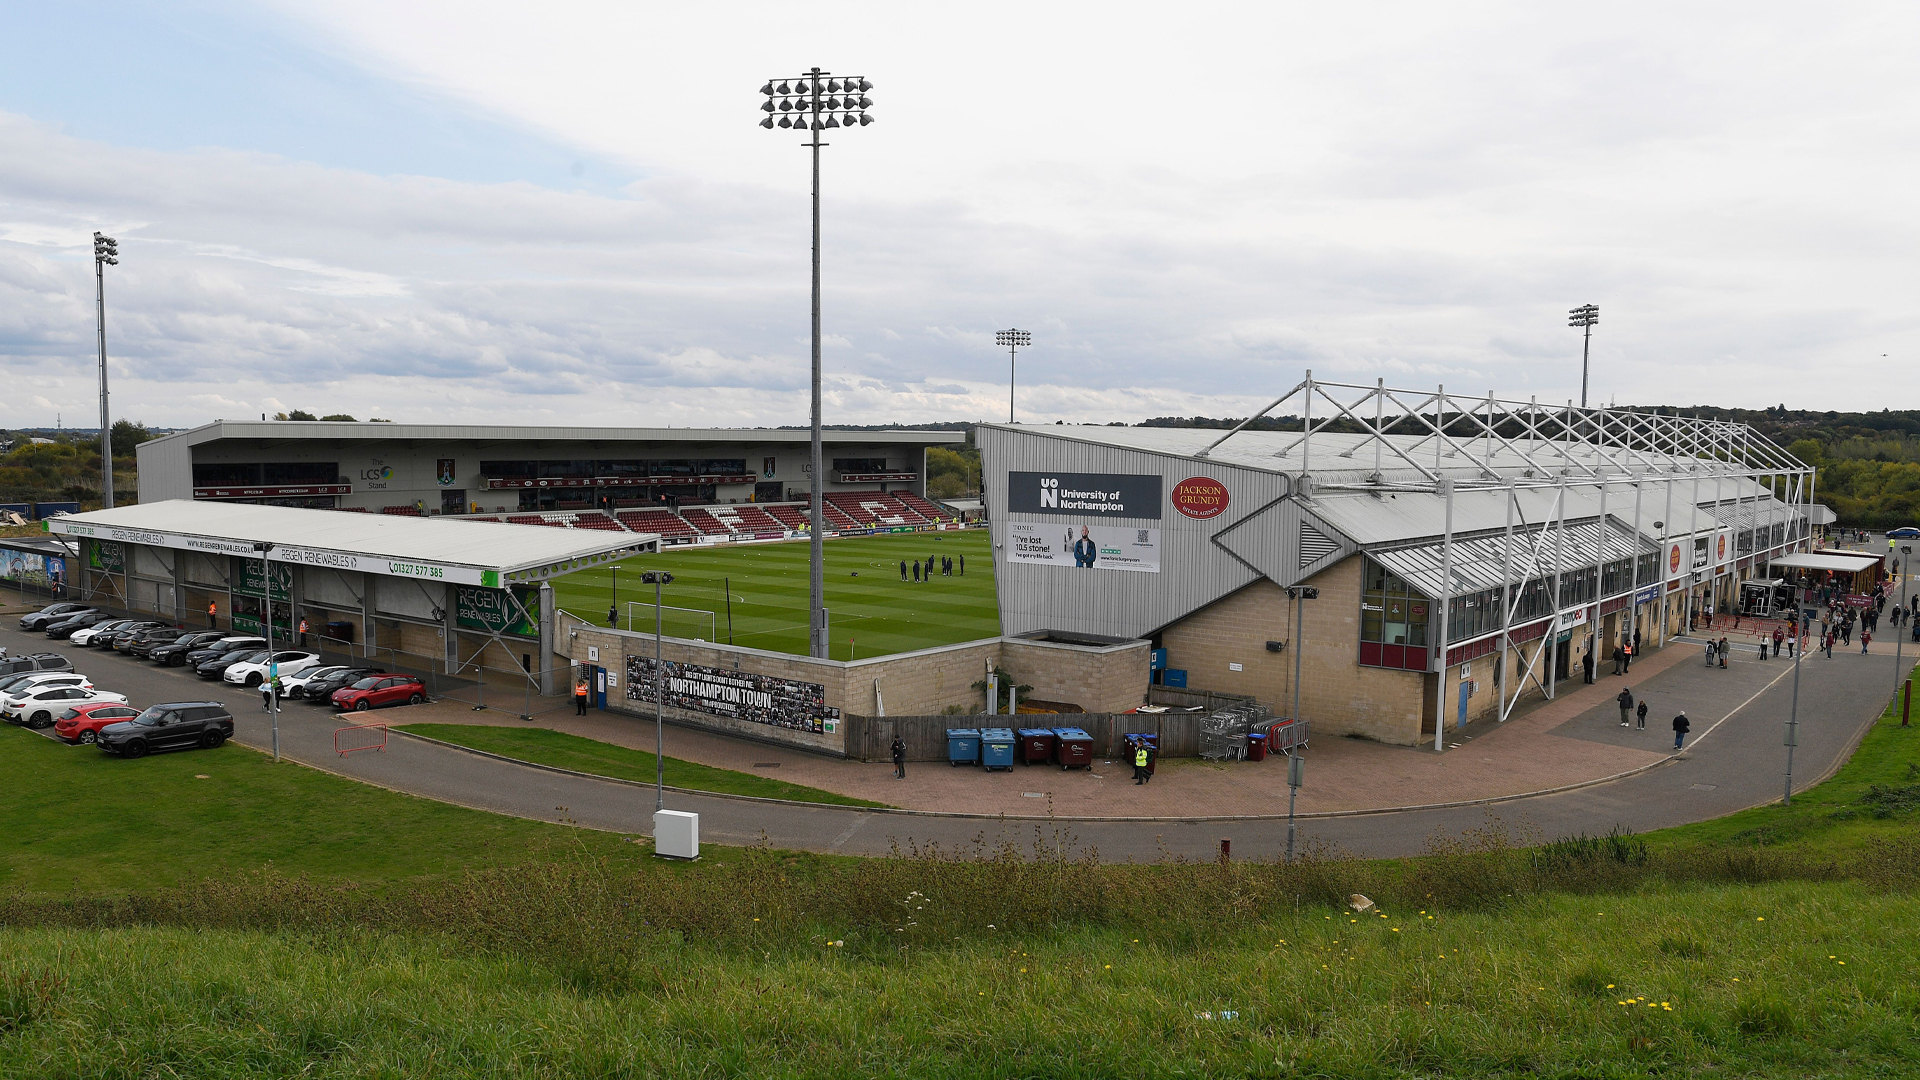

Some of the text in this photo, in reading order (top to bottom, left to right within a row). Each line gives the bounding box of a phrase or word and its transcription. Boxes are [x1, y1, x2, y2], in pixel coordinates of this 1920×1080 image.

[360, 469, 380, 480] LCS
[1060, 489, 1120, 501] University of
[1180, 485, 1221, 495] JACKSON
[1060, 500, 1124, 512] Northampton
[1180, 496, 1220, 505] GRUNDY
[1200, 506, 1218, 516] AGENTS
[1030, 536, 1041, 544] lost
[282, 549, 349, 568] REGEN RENEWABLES
[394, 564, 443, 578] 01327 577 385
[247, 578, 278, 591] RENEWALES
[460, 589, 500, 610] REGEN
[702, 673, 716, 682] LIGHTS
[729, 677, 745, 687] BOTHER
[670, 677, 772, 709] NORTHAMPTON TOWN
